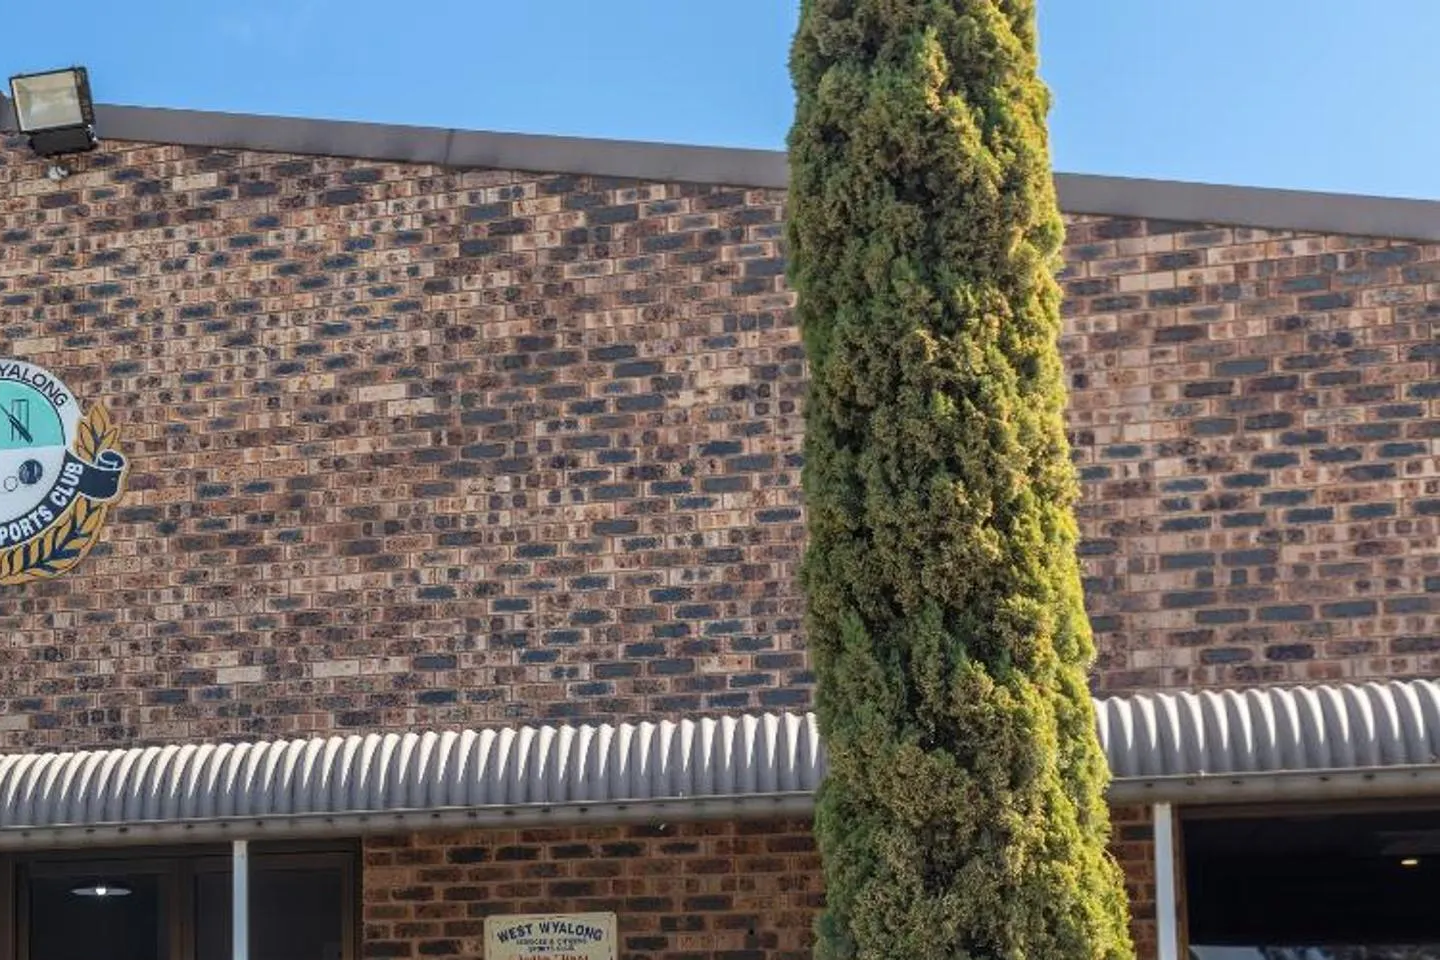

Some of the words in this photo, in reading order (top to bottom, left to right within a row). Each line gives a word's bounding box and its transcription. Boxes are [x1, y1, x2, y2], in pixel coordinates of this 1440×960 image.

[50, 461, 84, 507] CLUB
[497, 923, 533, 943] WEST
[539, 921, 603, 941] WYALONG
